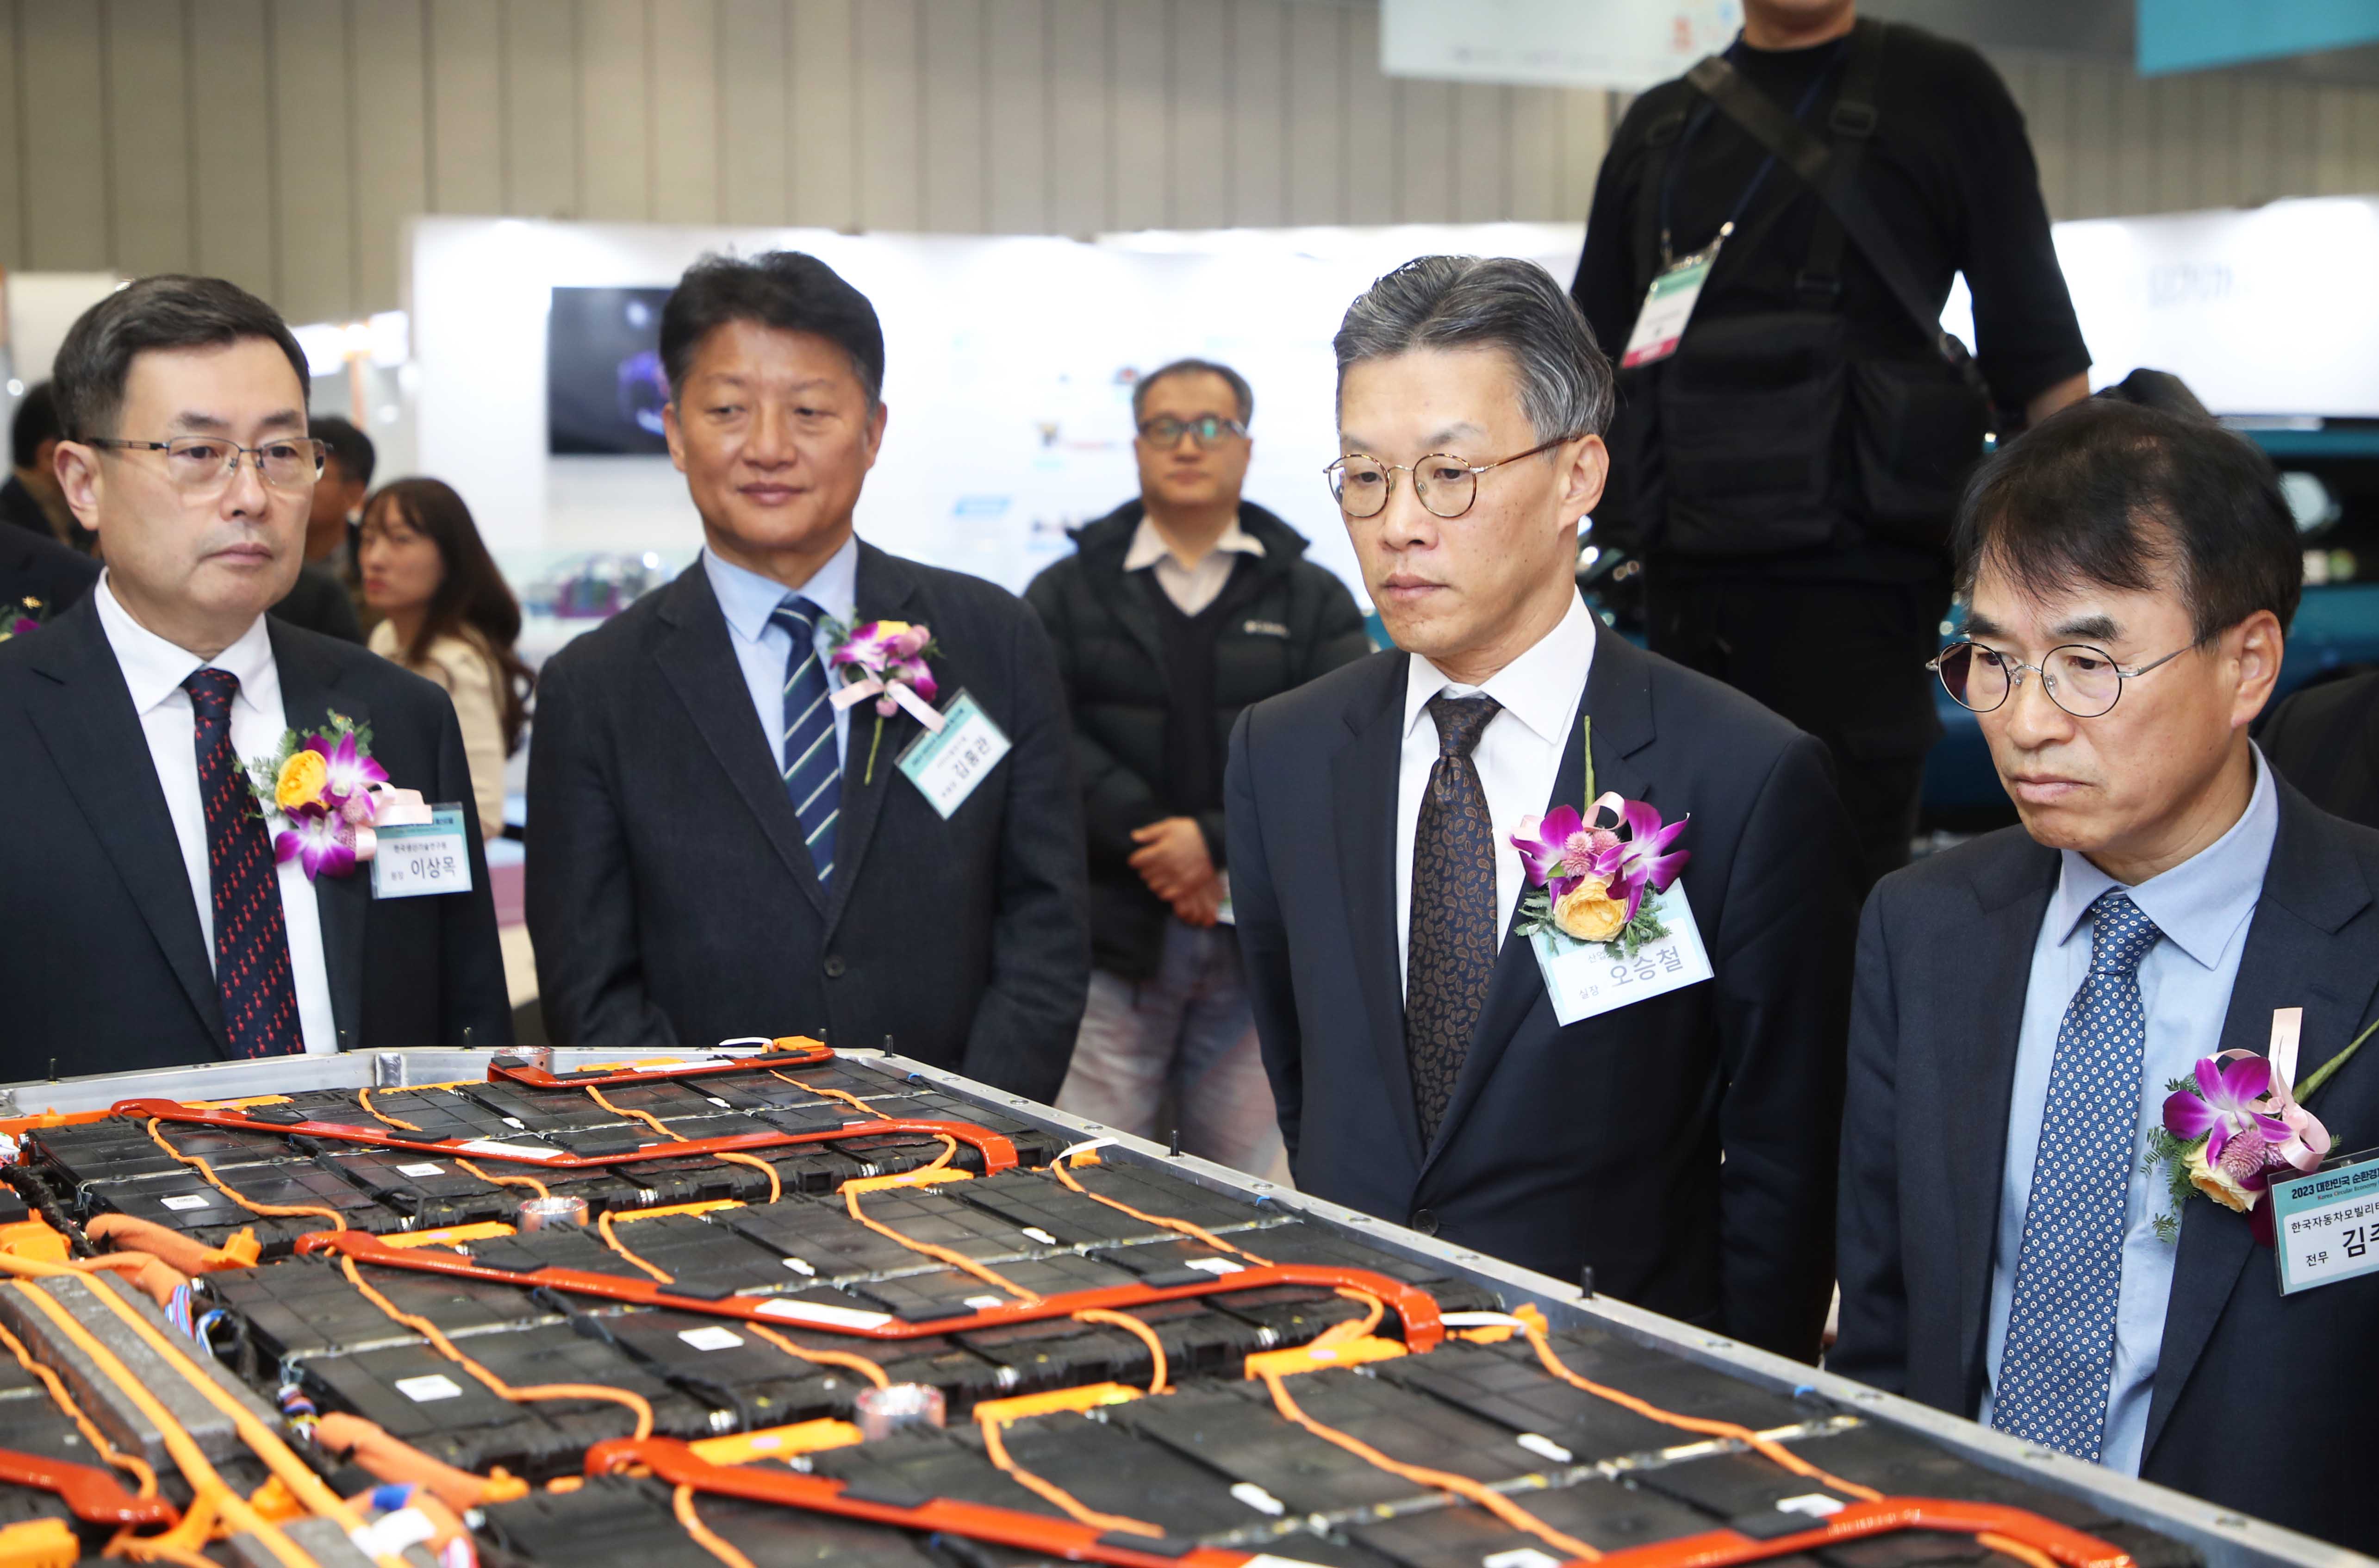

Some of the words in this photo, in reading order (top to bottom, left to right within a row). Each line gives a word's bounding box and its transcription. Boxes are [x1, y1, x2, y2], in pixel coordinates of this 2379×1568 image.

[411, 856, 455, 879] 이상목
[1579, 984, 1599, 1000] 실장
[1610, 945, 1683, 988] 오승철
[2292, 1185, 2314, 1200] 2023
[2316, 1176, 2350, 1193] 대한민국
[2352, 1168, 2379, 1184] 순환경
[2334, 1187, 2353, 1196] Circular
[2354, 1182, 2377, 1192] Economy
[2306, 1251, 2329, 1267] 전무
